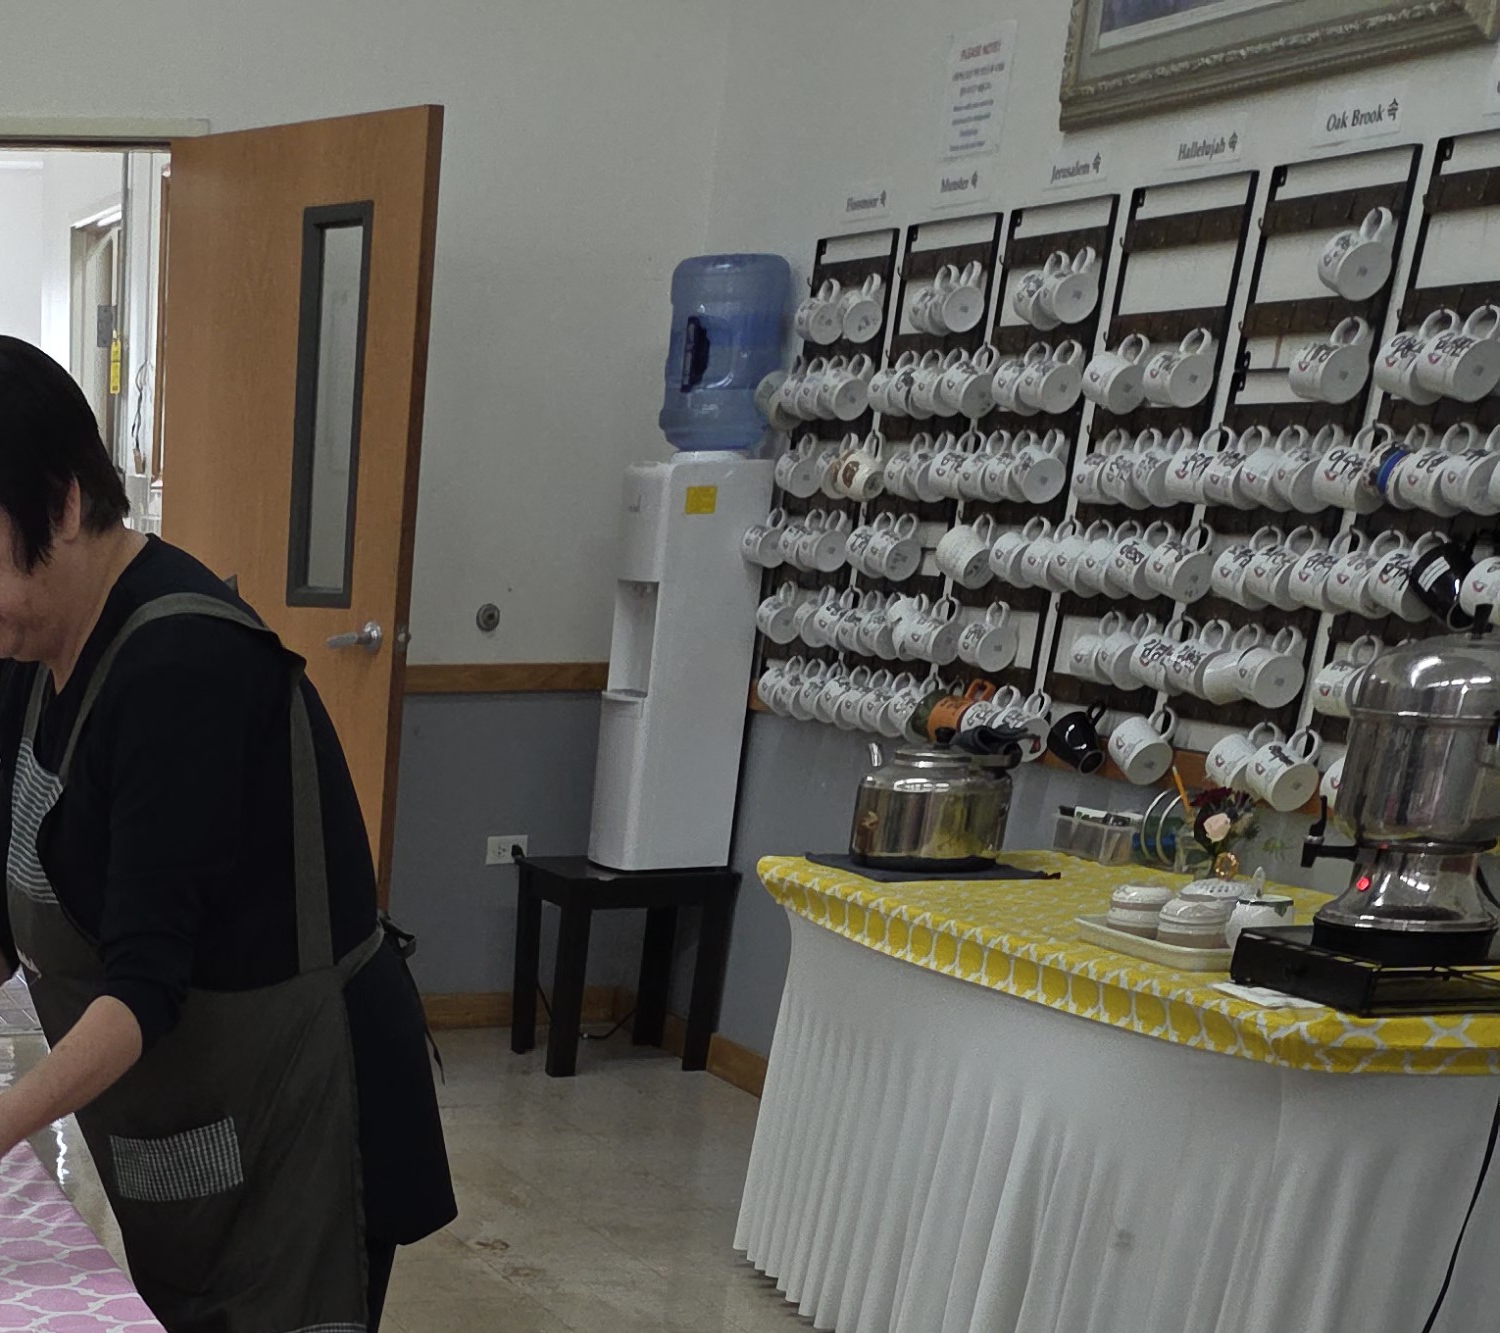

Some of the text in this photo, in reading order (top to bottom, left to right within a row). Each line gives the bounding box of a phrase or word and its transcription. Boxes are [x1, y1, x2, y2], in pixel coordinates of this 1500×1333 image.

[1326, 110, 1349, 132] Oak
[1351, 104, 1385, 127] Brook
[1177, 136, 1226, 161] Hallelujah
